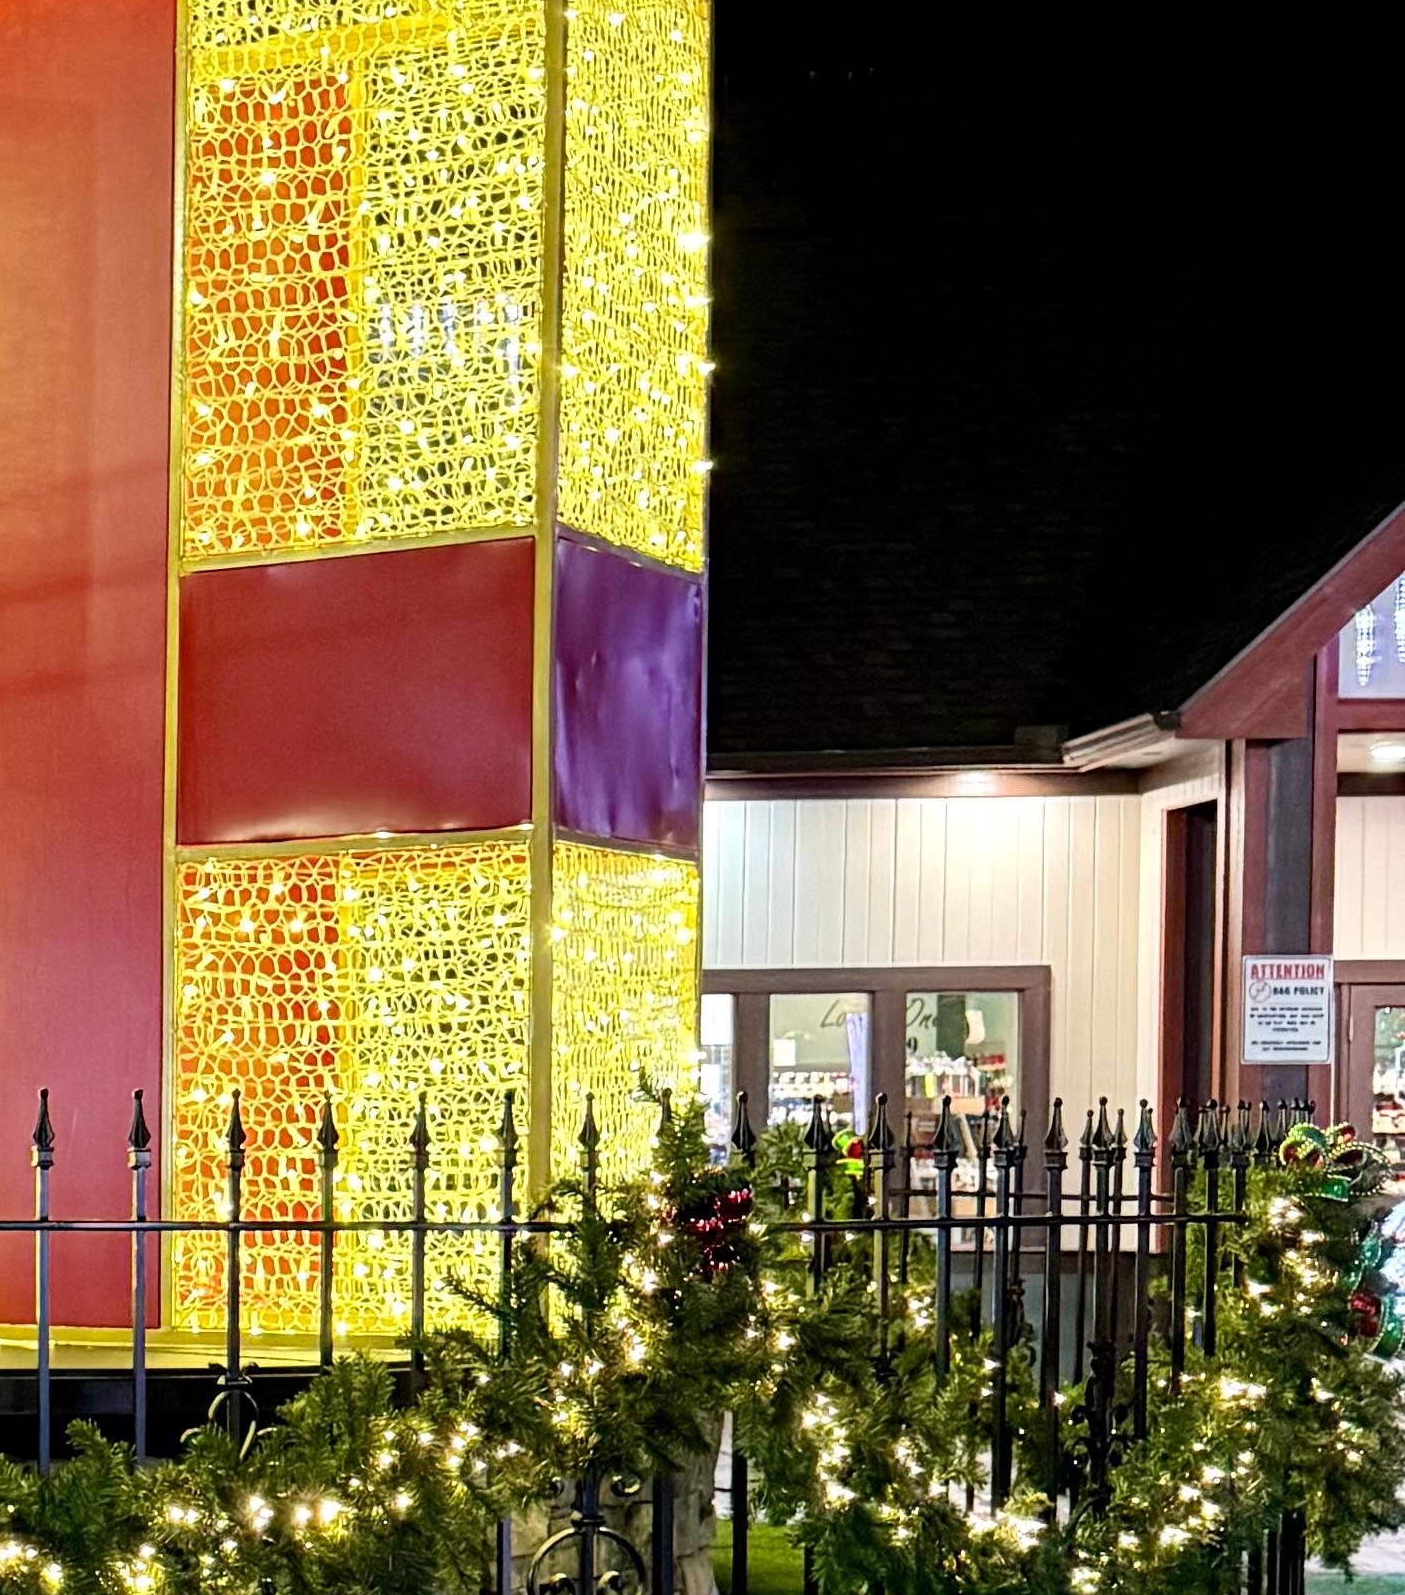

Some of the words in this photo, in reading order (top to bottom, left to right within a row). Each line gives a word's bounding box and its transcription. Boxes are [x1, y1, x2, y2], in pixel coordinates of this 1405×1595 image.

[1251, 964, 1325, 980] ATTENTION
[1273, 986, 1291, 996] BAG
[1294, 986, 1325, 996] POLICY
